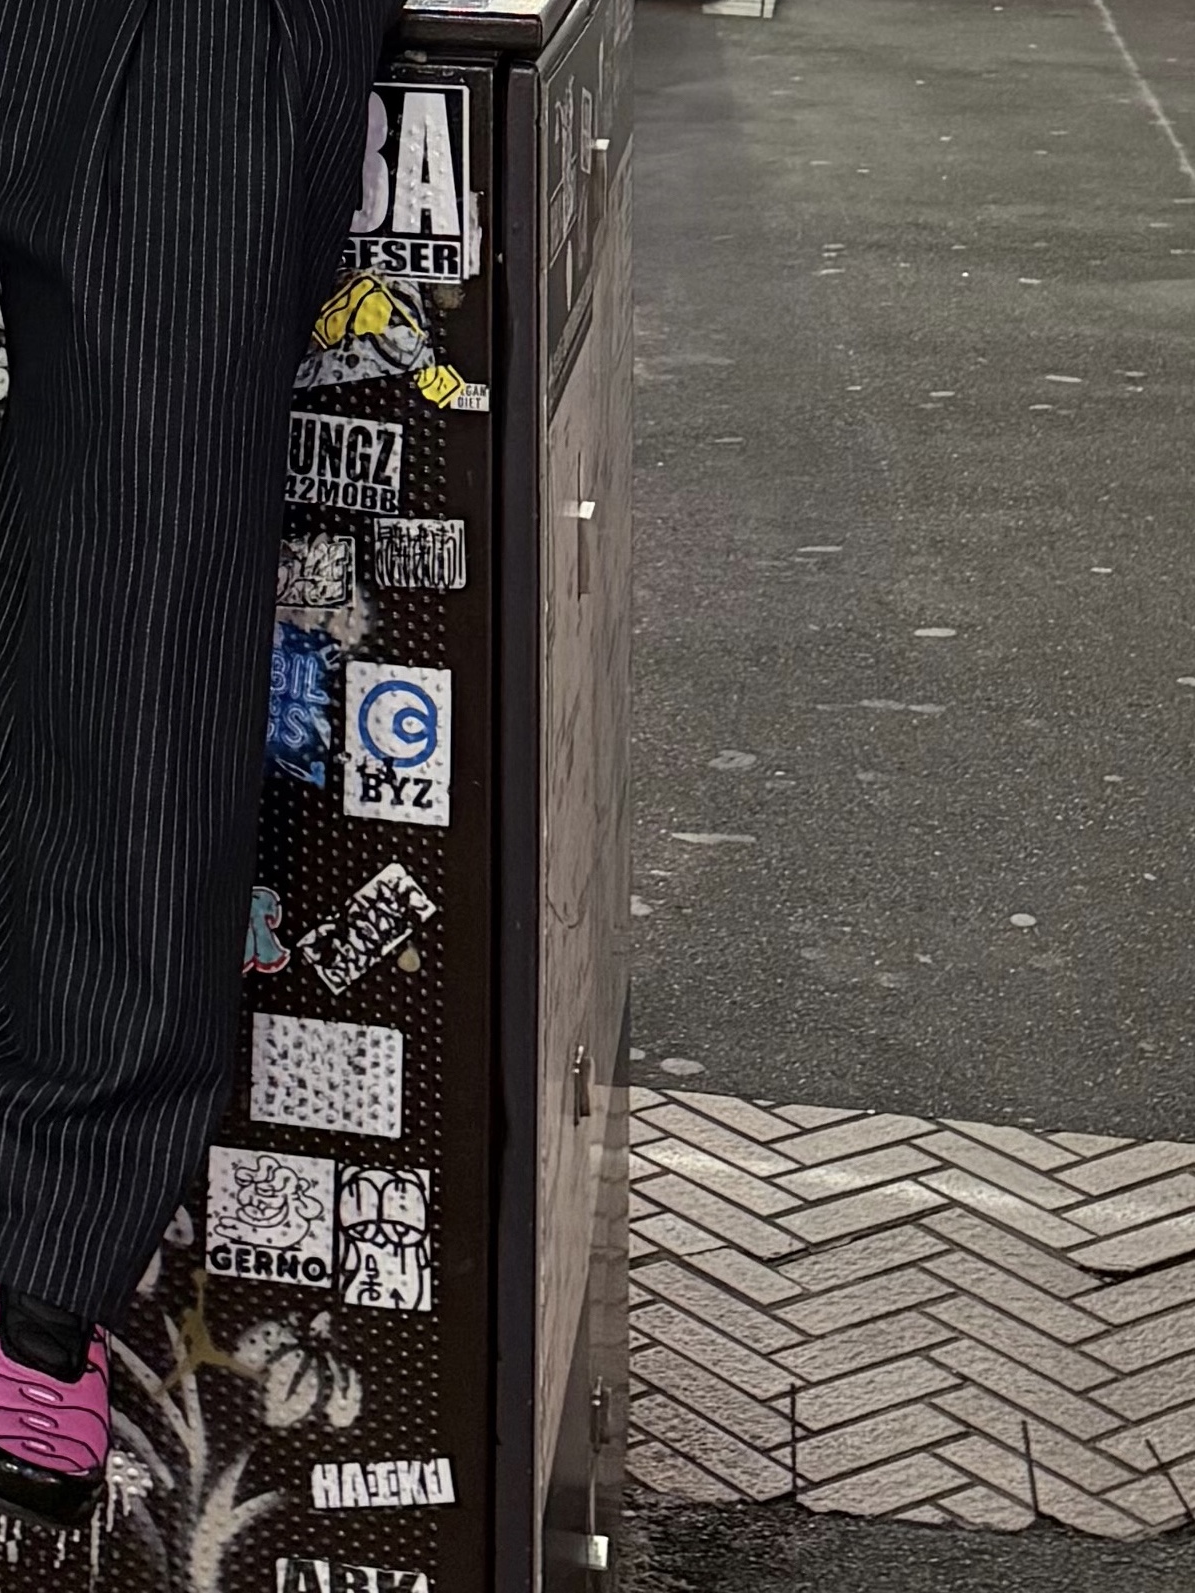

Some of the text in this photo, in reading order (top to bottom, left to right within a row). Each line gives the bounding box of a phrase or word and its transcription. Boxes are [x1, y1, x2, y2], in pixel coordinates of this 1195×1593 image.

[457, 396, 481, 409] DIET
[289, 417, 397, 488] UNGZ
[360, 777, 434, 808] BYZ
[210, 1244, 327, 1282] GERNO
[312, 1458, 456, 1508] HAIKU
